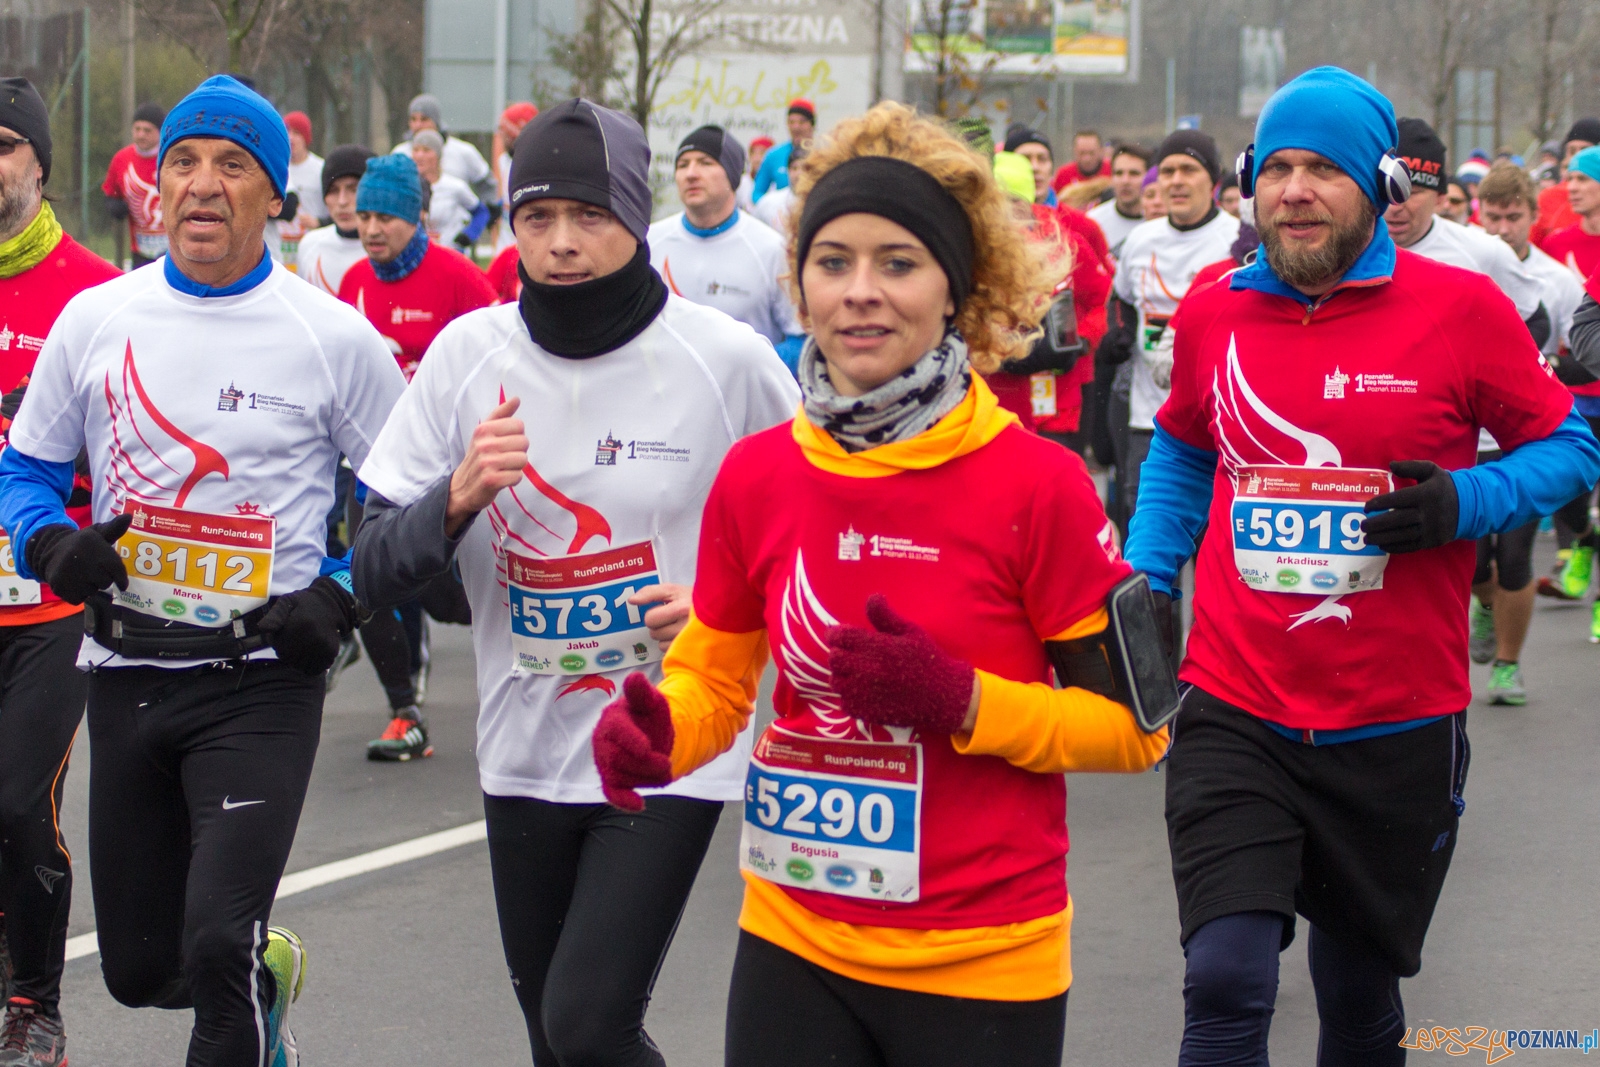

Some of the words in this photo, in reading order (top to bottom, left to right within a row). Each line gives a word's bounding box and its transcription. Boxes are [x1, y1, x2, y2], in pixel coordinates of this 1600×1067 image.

[16, 333, 24, 349] 1
[1355, 373, 1365, 392] 1
[248, 392, 257, 410] 1
[627, 440, 637, 459] 1
[1311, 482, 1380, 495] RunPoland.org
[201, 525, 264, 542] RunPoland.org
[1235, 518, 1245, 532] E
[1250, 507, 1368, 551] 5919
[869, 534, 881, 556] 1
[120, 546, 131, 559] D
[134, 541, 254, 592] 8112
[573, 556, 644, 578] RunPoland.org
[1276, 556, 1329, 567] Arkadiusz
[1241, 568, 1259, 577] GRUPA
[173, 588, 203, 601] Marek
[512, 602, 520, 618] E
[522, 586, 641, 635] 5731
[566, 640, 599, 651] Jakub
[519, 652, 538, 663] GRUPA
[519, 660, 544, 671] LUXMED
[824, 754, 906, 774] RunPoland.org
[747, 784, 754, 802] E
[756, 776, 895, 844] 5290
[791, 842, 839, 859] Bogusia
